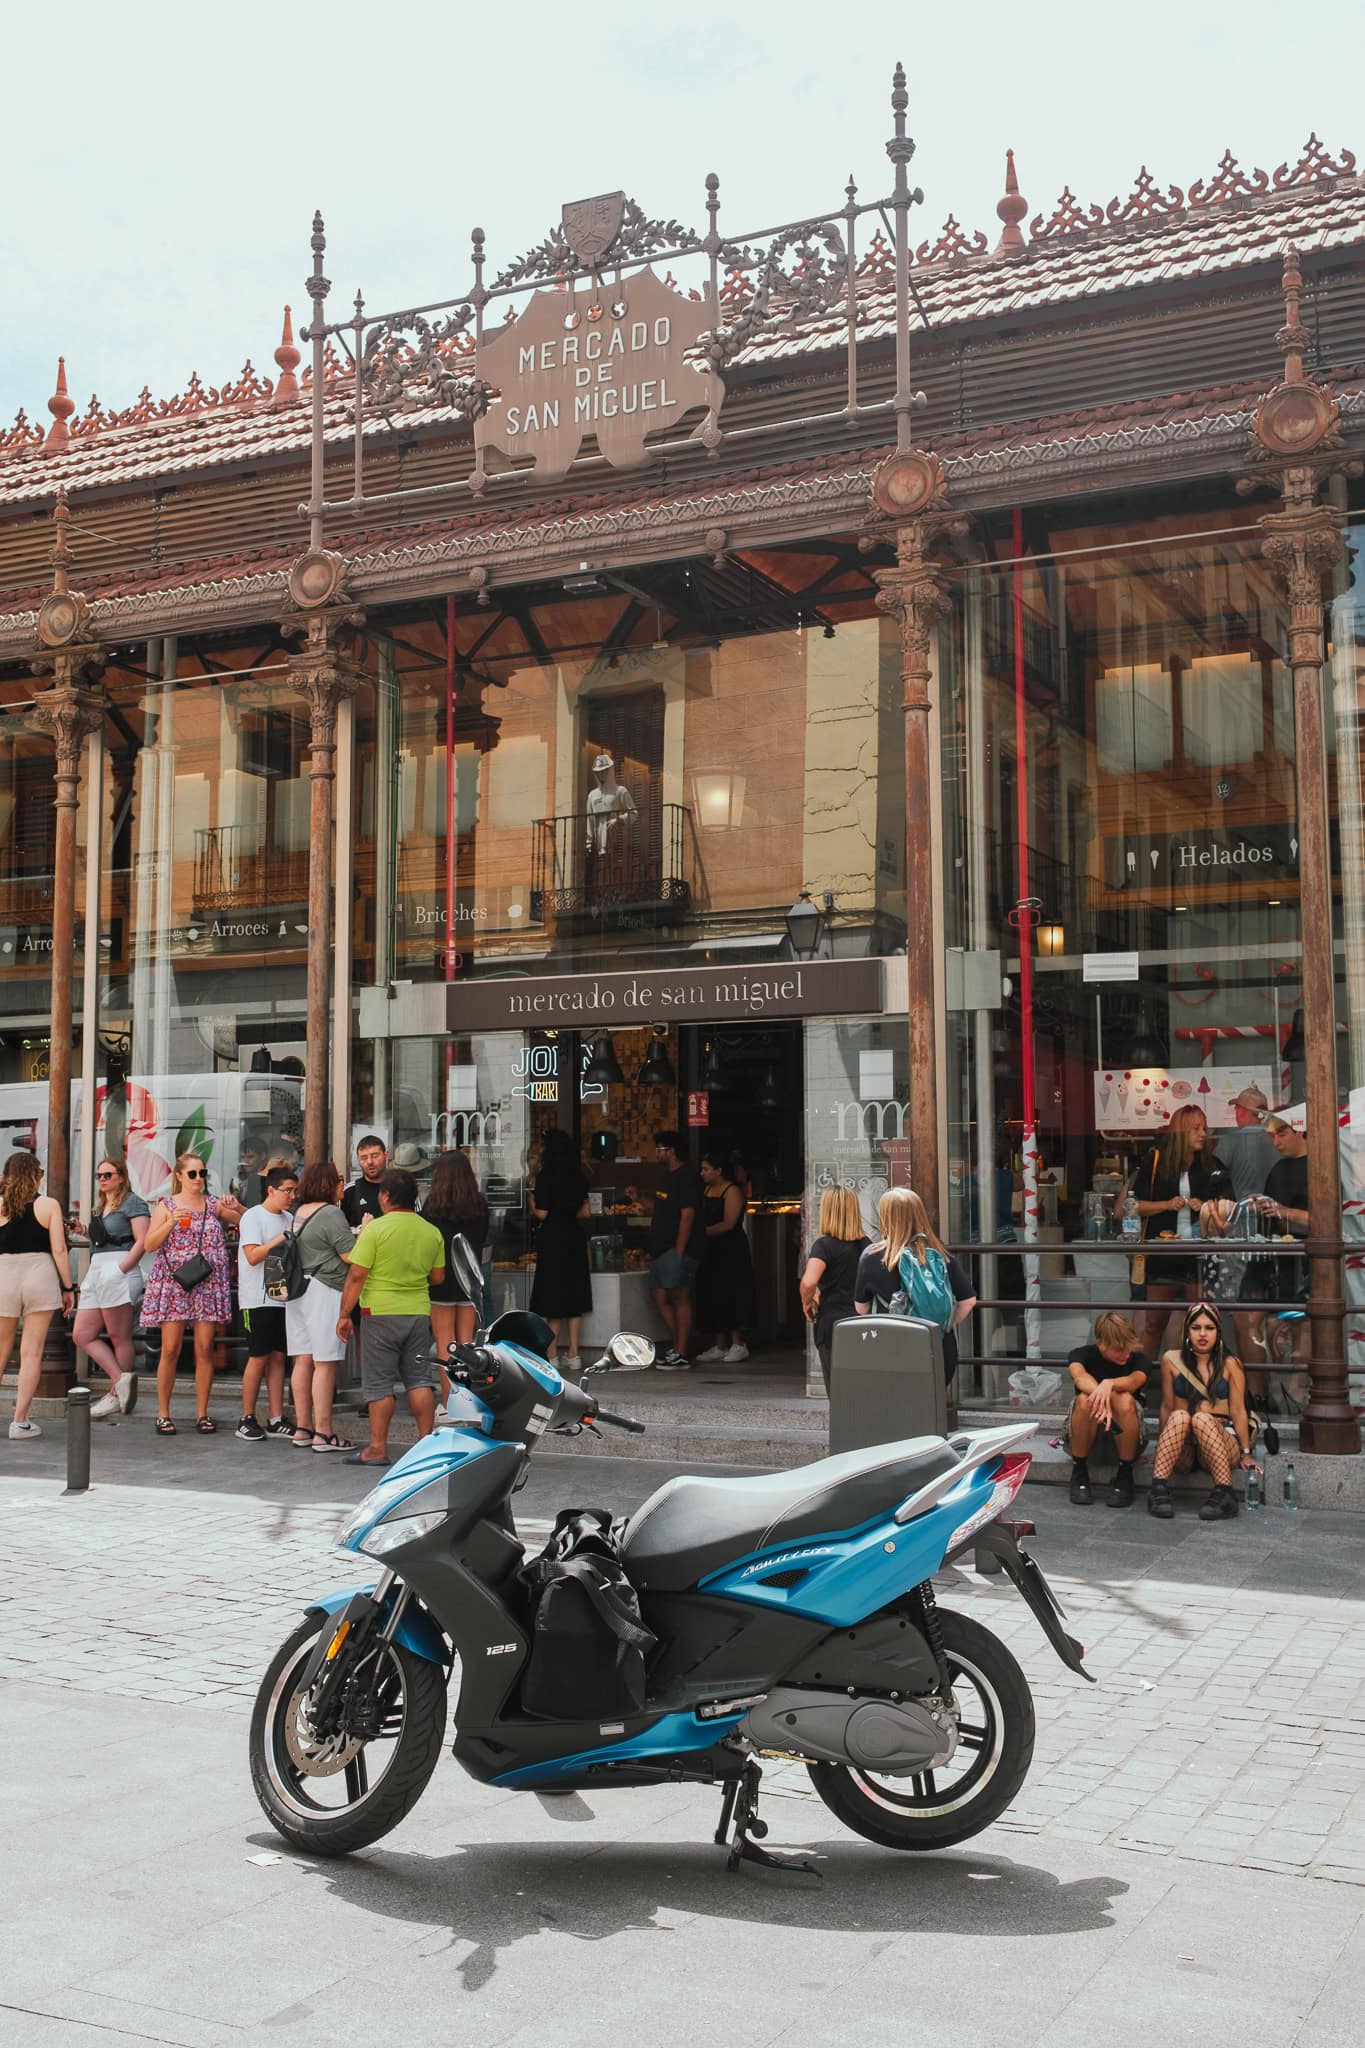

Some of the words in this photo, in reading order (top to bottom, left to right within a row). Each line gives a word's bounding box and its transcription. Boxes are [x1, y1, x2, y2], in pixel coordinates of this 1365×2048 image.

[518, 317, 671, 374] MERCADO
[575, 363, 613, 387] DE
[506, 399, 560, 435] SAN
[1179, 842, 1273, 868] Helados
[210, 919, 269, 937] Arroces
[509, 983, 615, 1013] mercado
[623, 980, 653, 1008] de
[660, 985, 705, 1005] san
[715, 971, 804, 1011] miguel
[486, 1643, 518, 1656] 125
